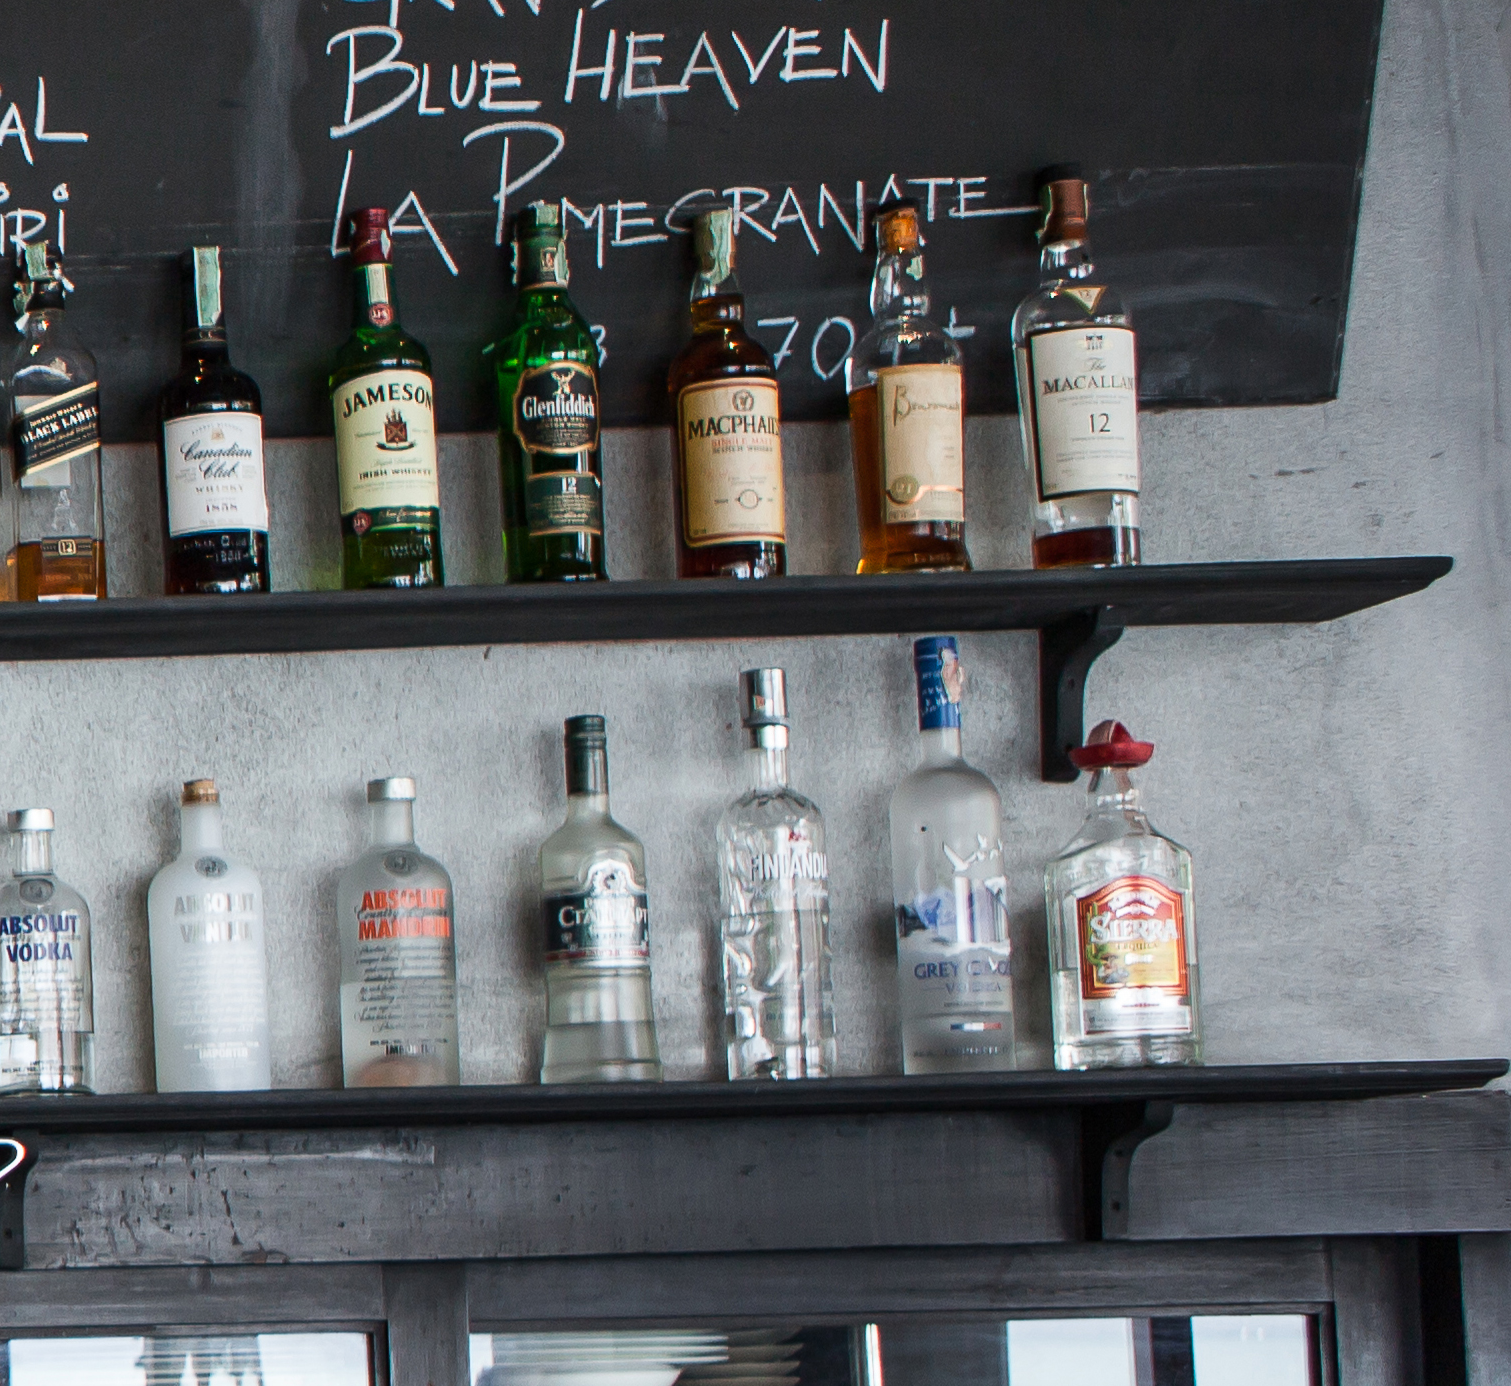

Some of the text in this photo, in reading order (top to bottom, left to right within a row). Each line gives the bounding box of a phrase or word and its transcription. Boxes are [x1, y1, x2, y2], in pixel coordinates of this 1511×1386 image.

[326, 8, 890, 140] BLUE HEAVEN
[330, 147, 461, 277] LA
[342, 381, 434, 420] JAMESON
[1088, 412, 1111, 434] 12
[179, 439, 253, 462] Canadian
[199, 457, 240, 481] Club
[562, 476, 577, 492] 12
[60, 540, 74, 553] 12
[361, 888, 447, 912] ABSOLUT
[1089, 910, 1181, 944] SIERRA
[5, 942, 74, 963] VODKA
[913, 960, 959, 979] GREY
